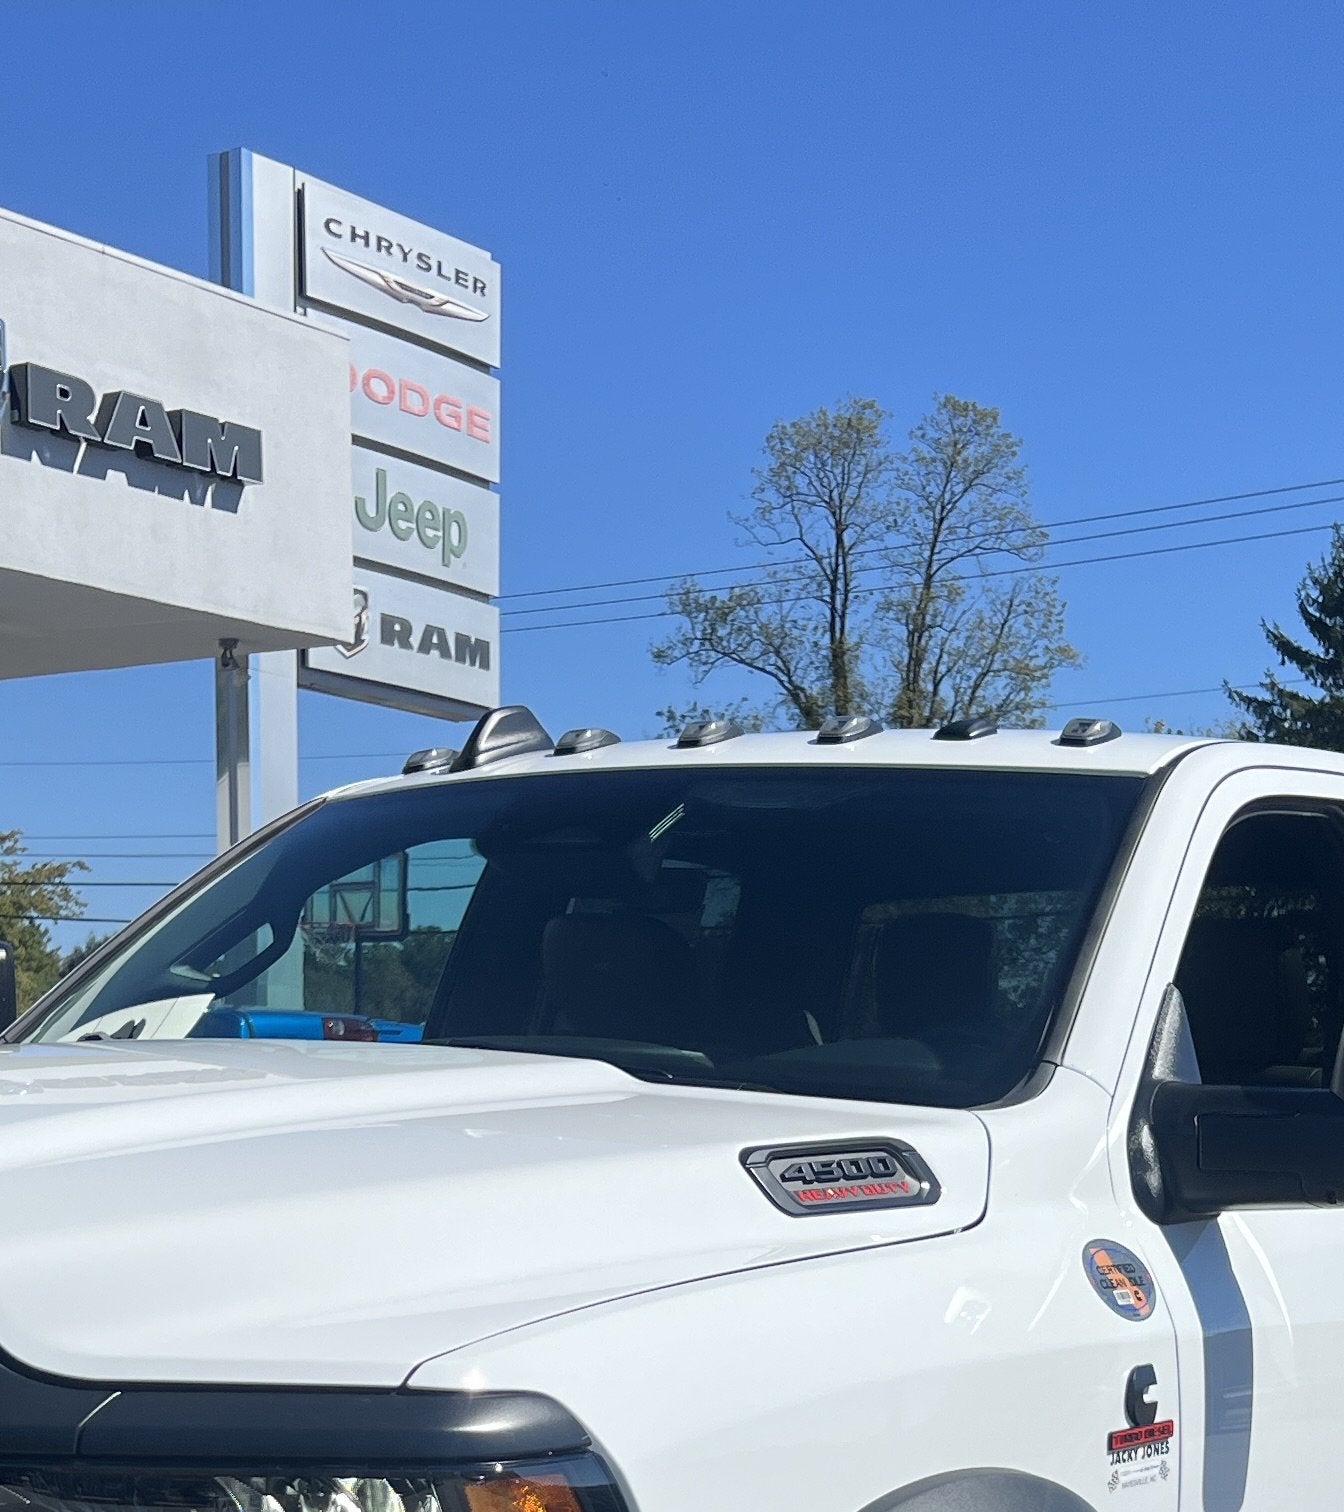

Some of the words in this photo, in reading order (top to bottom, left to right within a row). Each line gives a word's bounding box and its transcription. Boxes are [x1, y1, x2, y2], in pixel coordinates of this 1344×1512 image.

[323, 217, 487, 297] CHRYSLER
[14, 362, 264, 485] RAM
[354, 467, 468, 568] Jeep
[379, 612, 491, 671] RAM
[779, 1155, 897, 1185] 4500
[1110, 1448, 1138, 1466] JACKY
[1141, 1440, 1170, 1460] JONES
